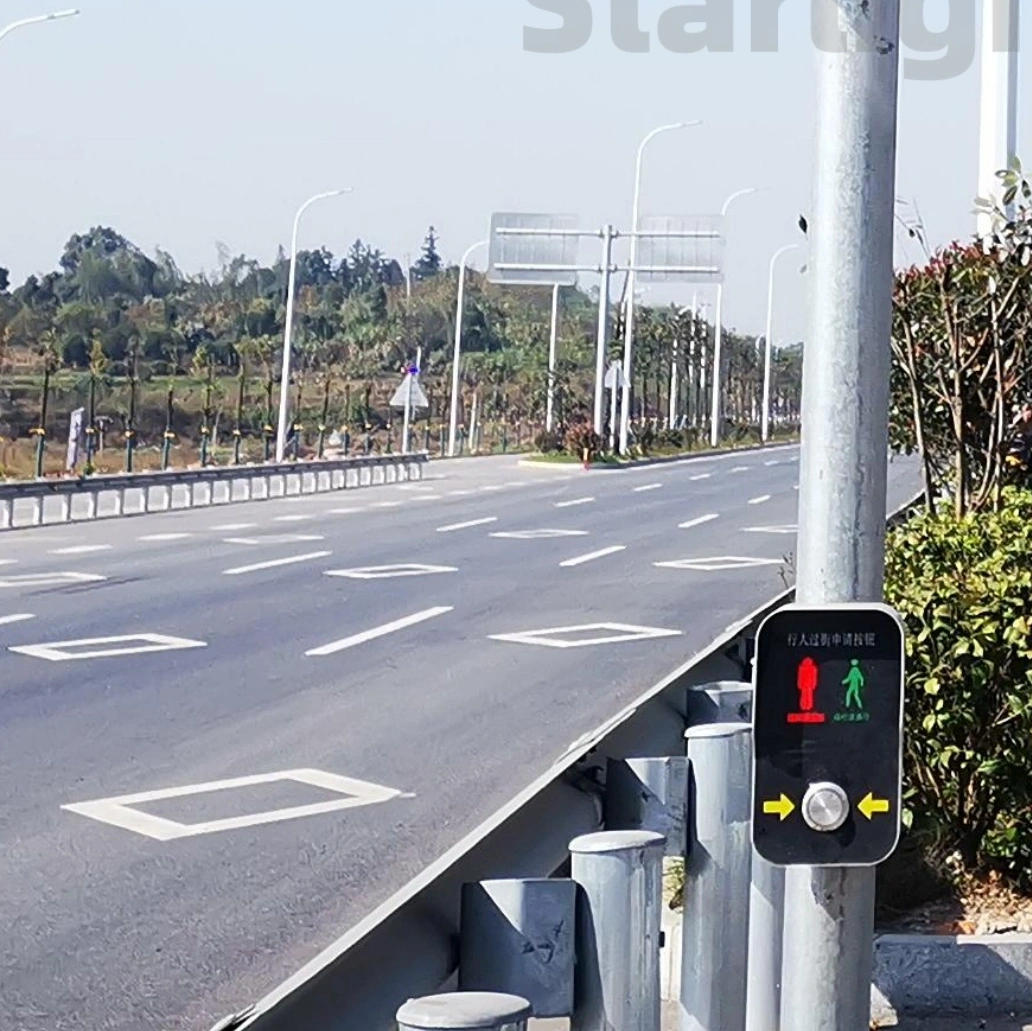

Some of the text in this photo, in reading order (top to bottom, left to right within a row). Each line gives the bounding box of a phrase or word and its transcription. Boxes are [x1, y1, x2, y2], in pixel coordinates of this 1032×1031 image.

[787, 632, 876, 648] 行人过街申请按钮
